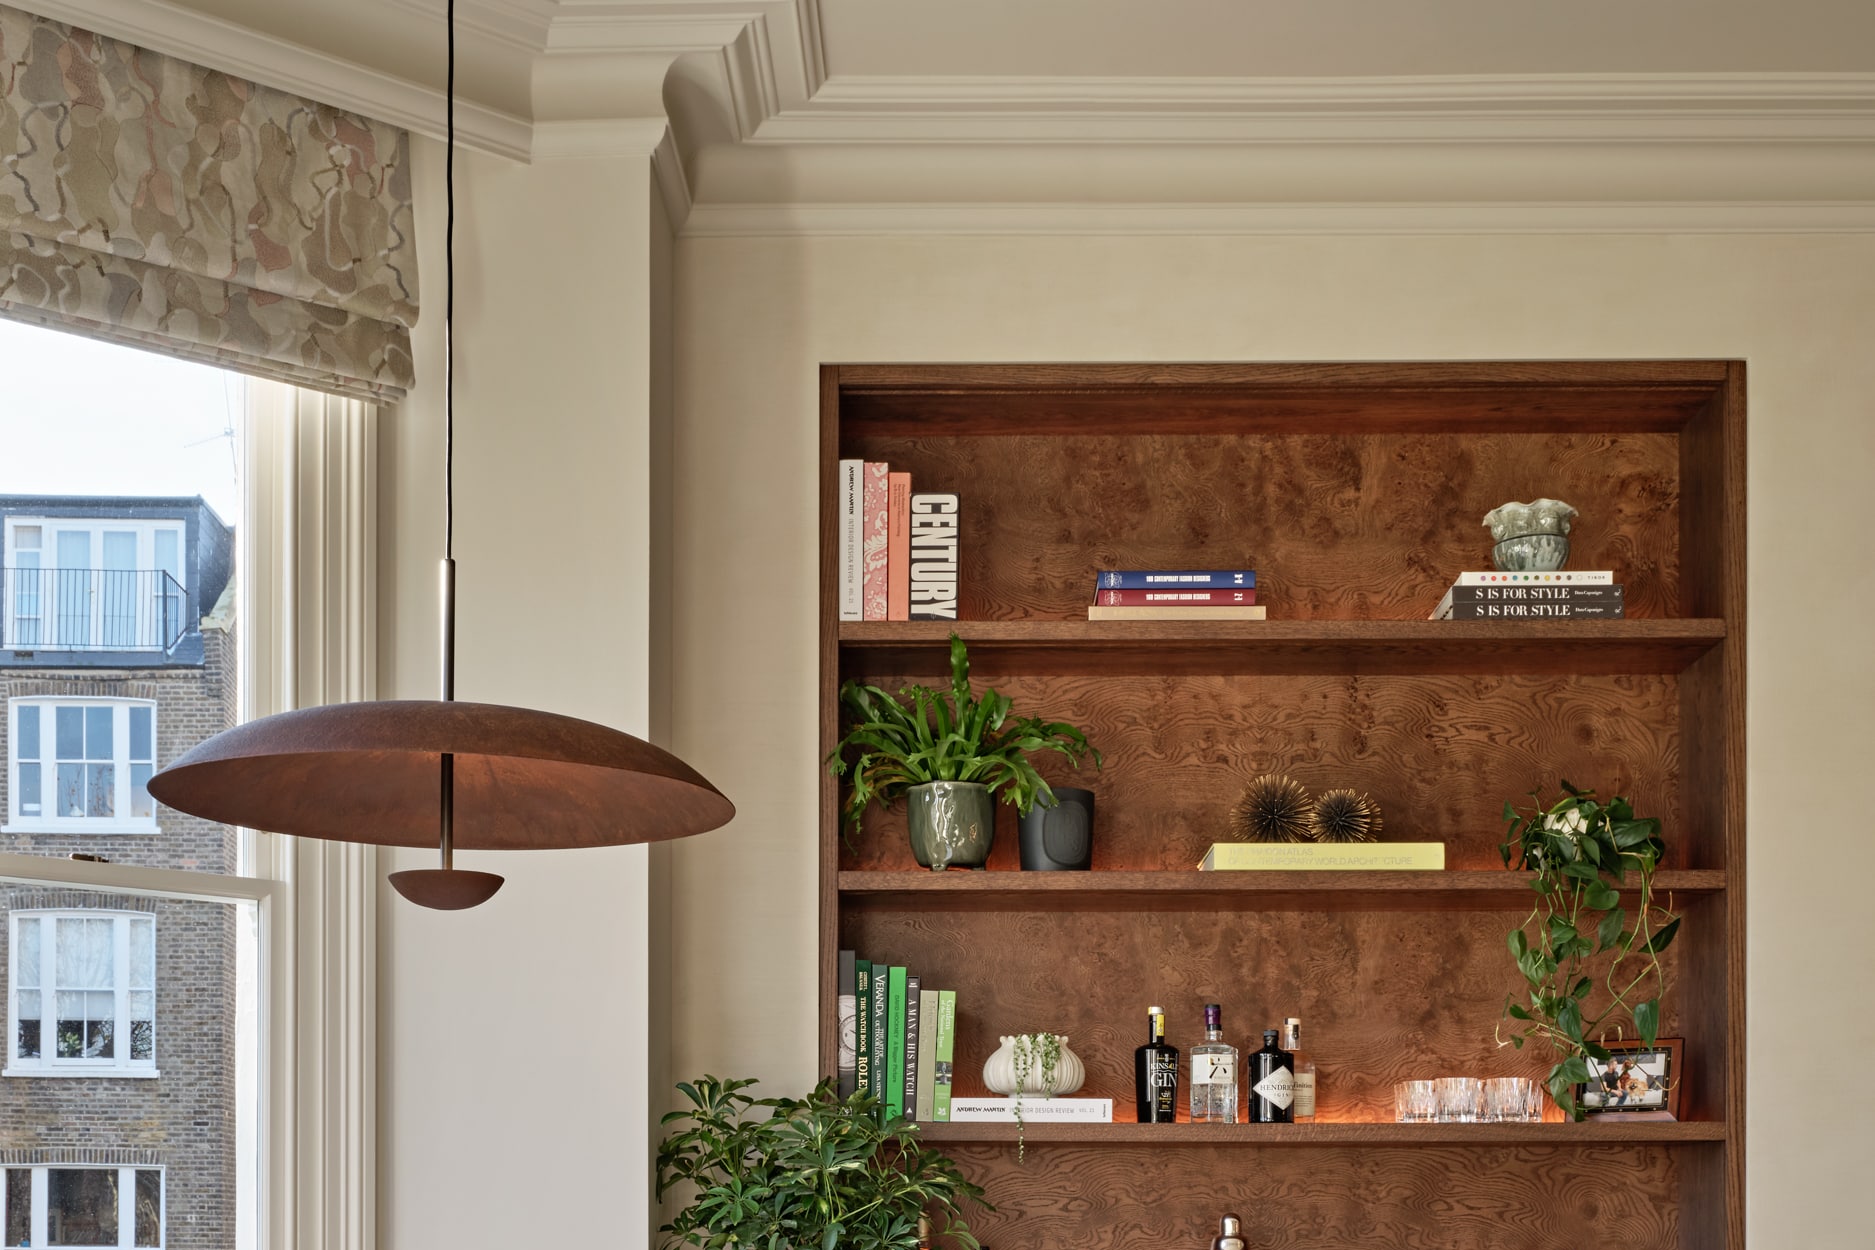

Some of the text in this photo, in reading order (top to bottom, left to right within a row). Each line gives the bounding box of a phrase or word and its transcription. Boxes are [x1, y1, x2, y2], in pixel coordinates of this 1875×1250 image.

[911, 494, 957, 619] CENTURY
[1475, 588, 1570, 599] S IS FOR STYLE
[1476, 605, 1571, 616] S IS FOR STYLE
[1314, 857, 1346, 865] WORLD
[1348, 857, 1413, 865] ARCHITCTURE
[875, 974, 885, 1017] VERANDA
[907, 1009, 917, 1029] MAN
[945, 1000, 953, 1030] Gardens
[907, 1043, 915, 1060] HIS
[906, 1061, 915, 1096] WATCH
[1150, 1072, 1177, 1087] GIN
